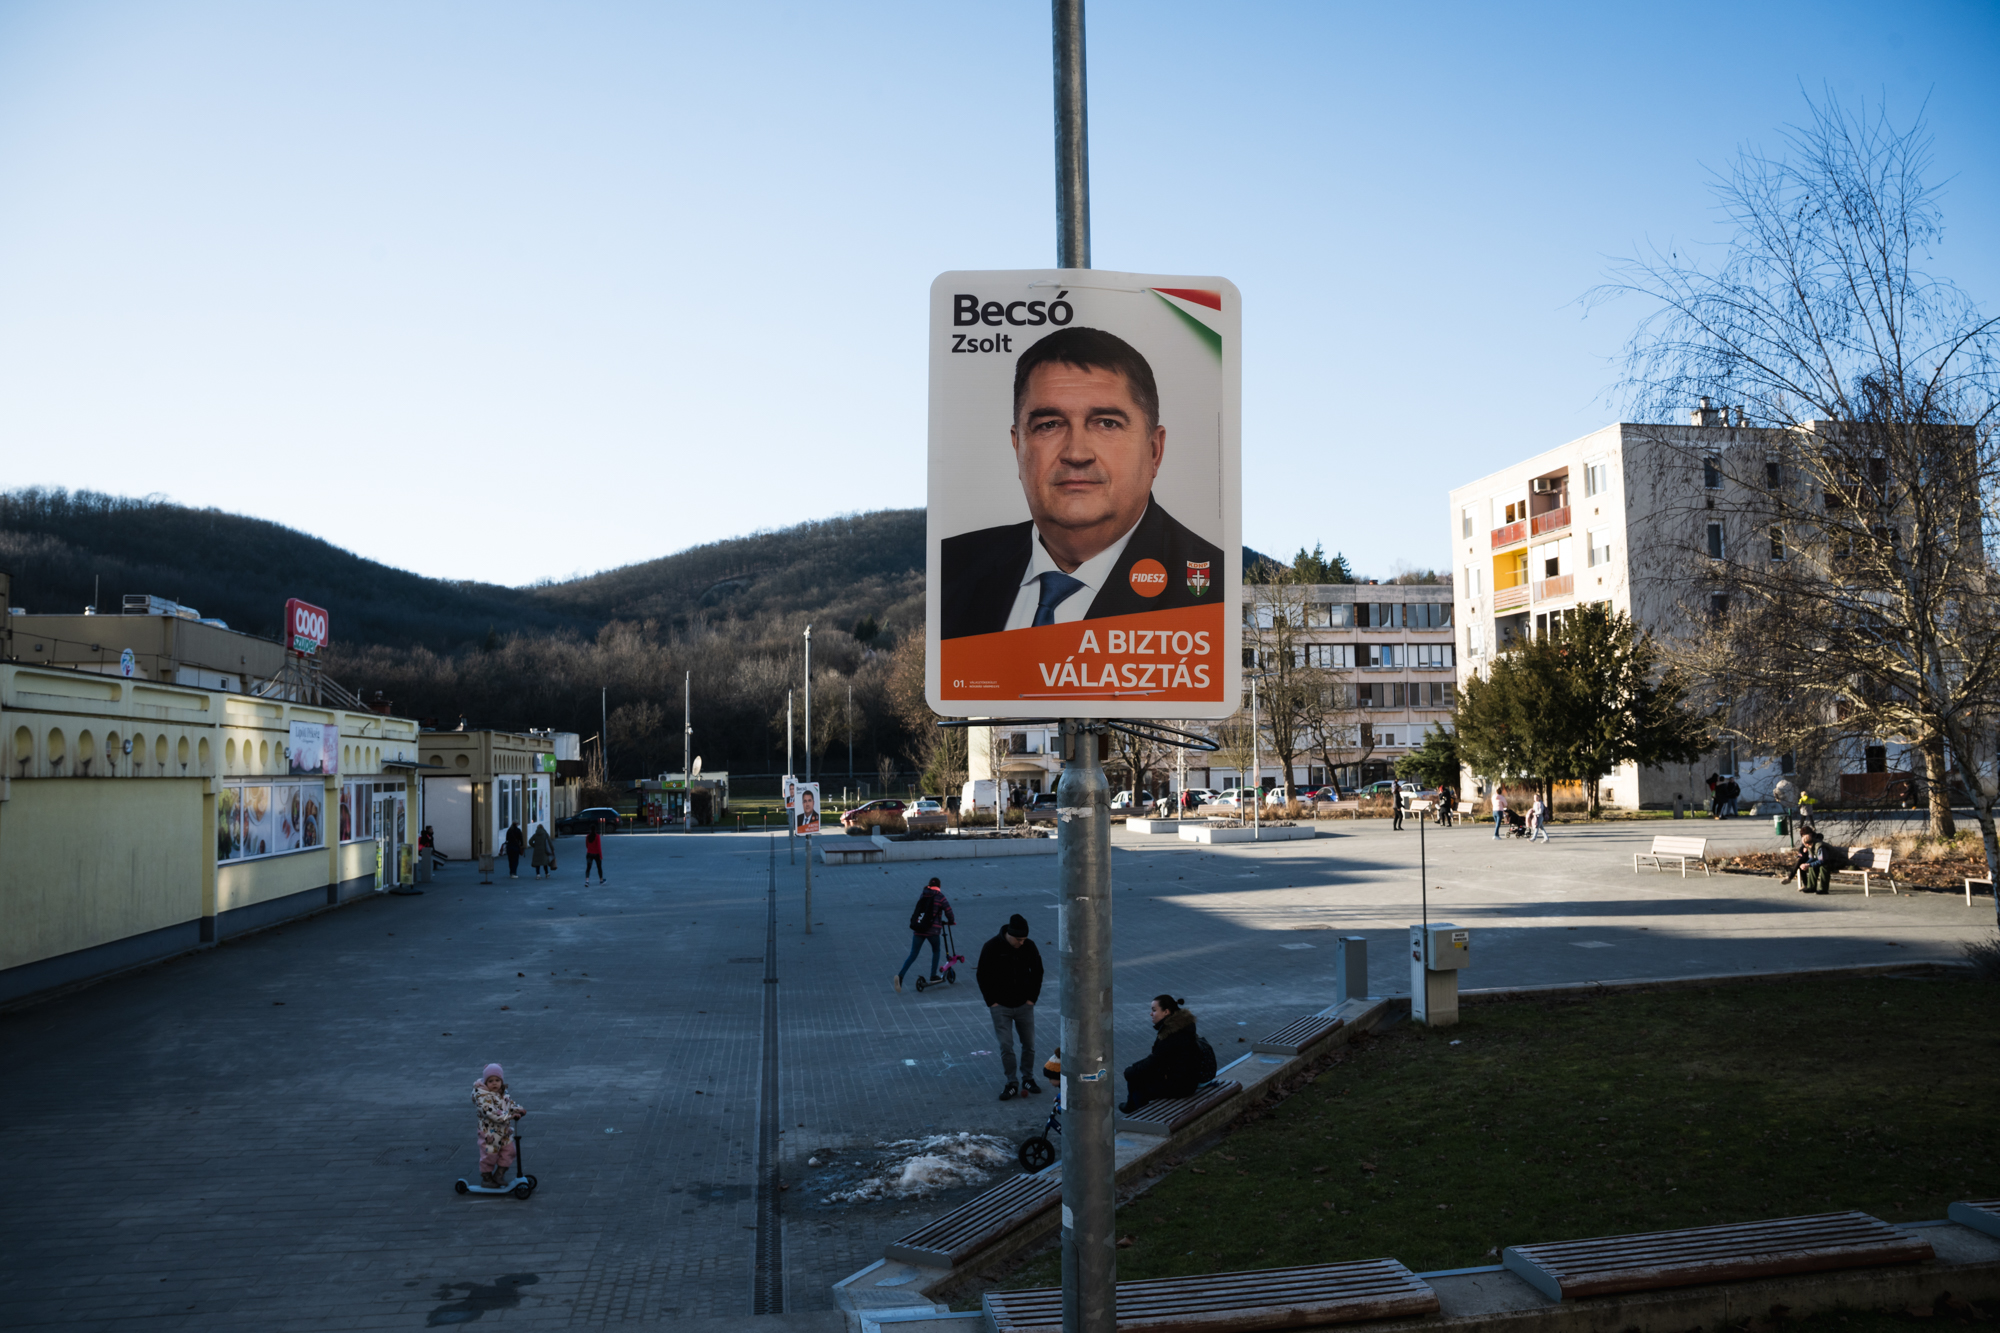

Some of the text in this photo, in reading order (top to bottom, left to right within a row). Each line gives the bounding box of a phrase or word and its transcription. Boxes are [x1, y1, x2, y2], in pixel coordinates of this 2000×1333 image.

[953, 291, 1074, 326] Becsó
[952, 333, 1012, 353] Zsolt
[1131, 573, 1166, 583] FIDESZ
[1078, 629, 1211, 655] A BIZTOS
[953, 679, 967, 688] 01.
[1039, 656, 1211, 688] VÁLASZTÁS
